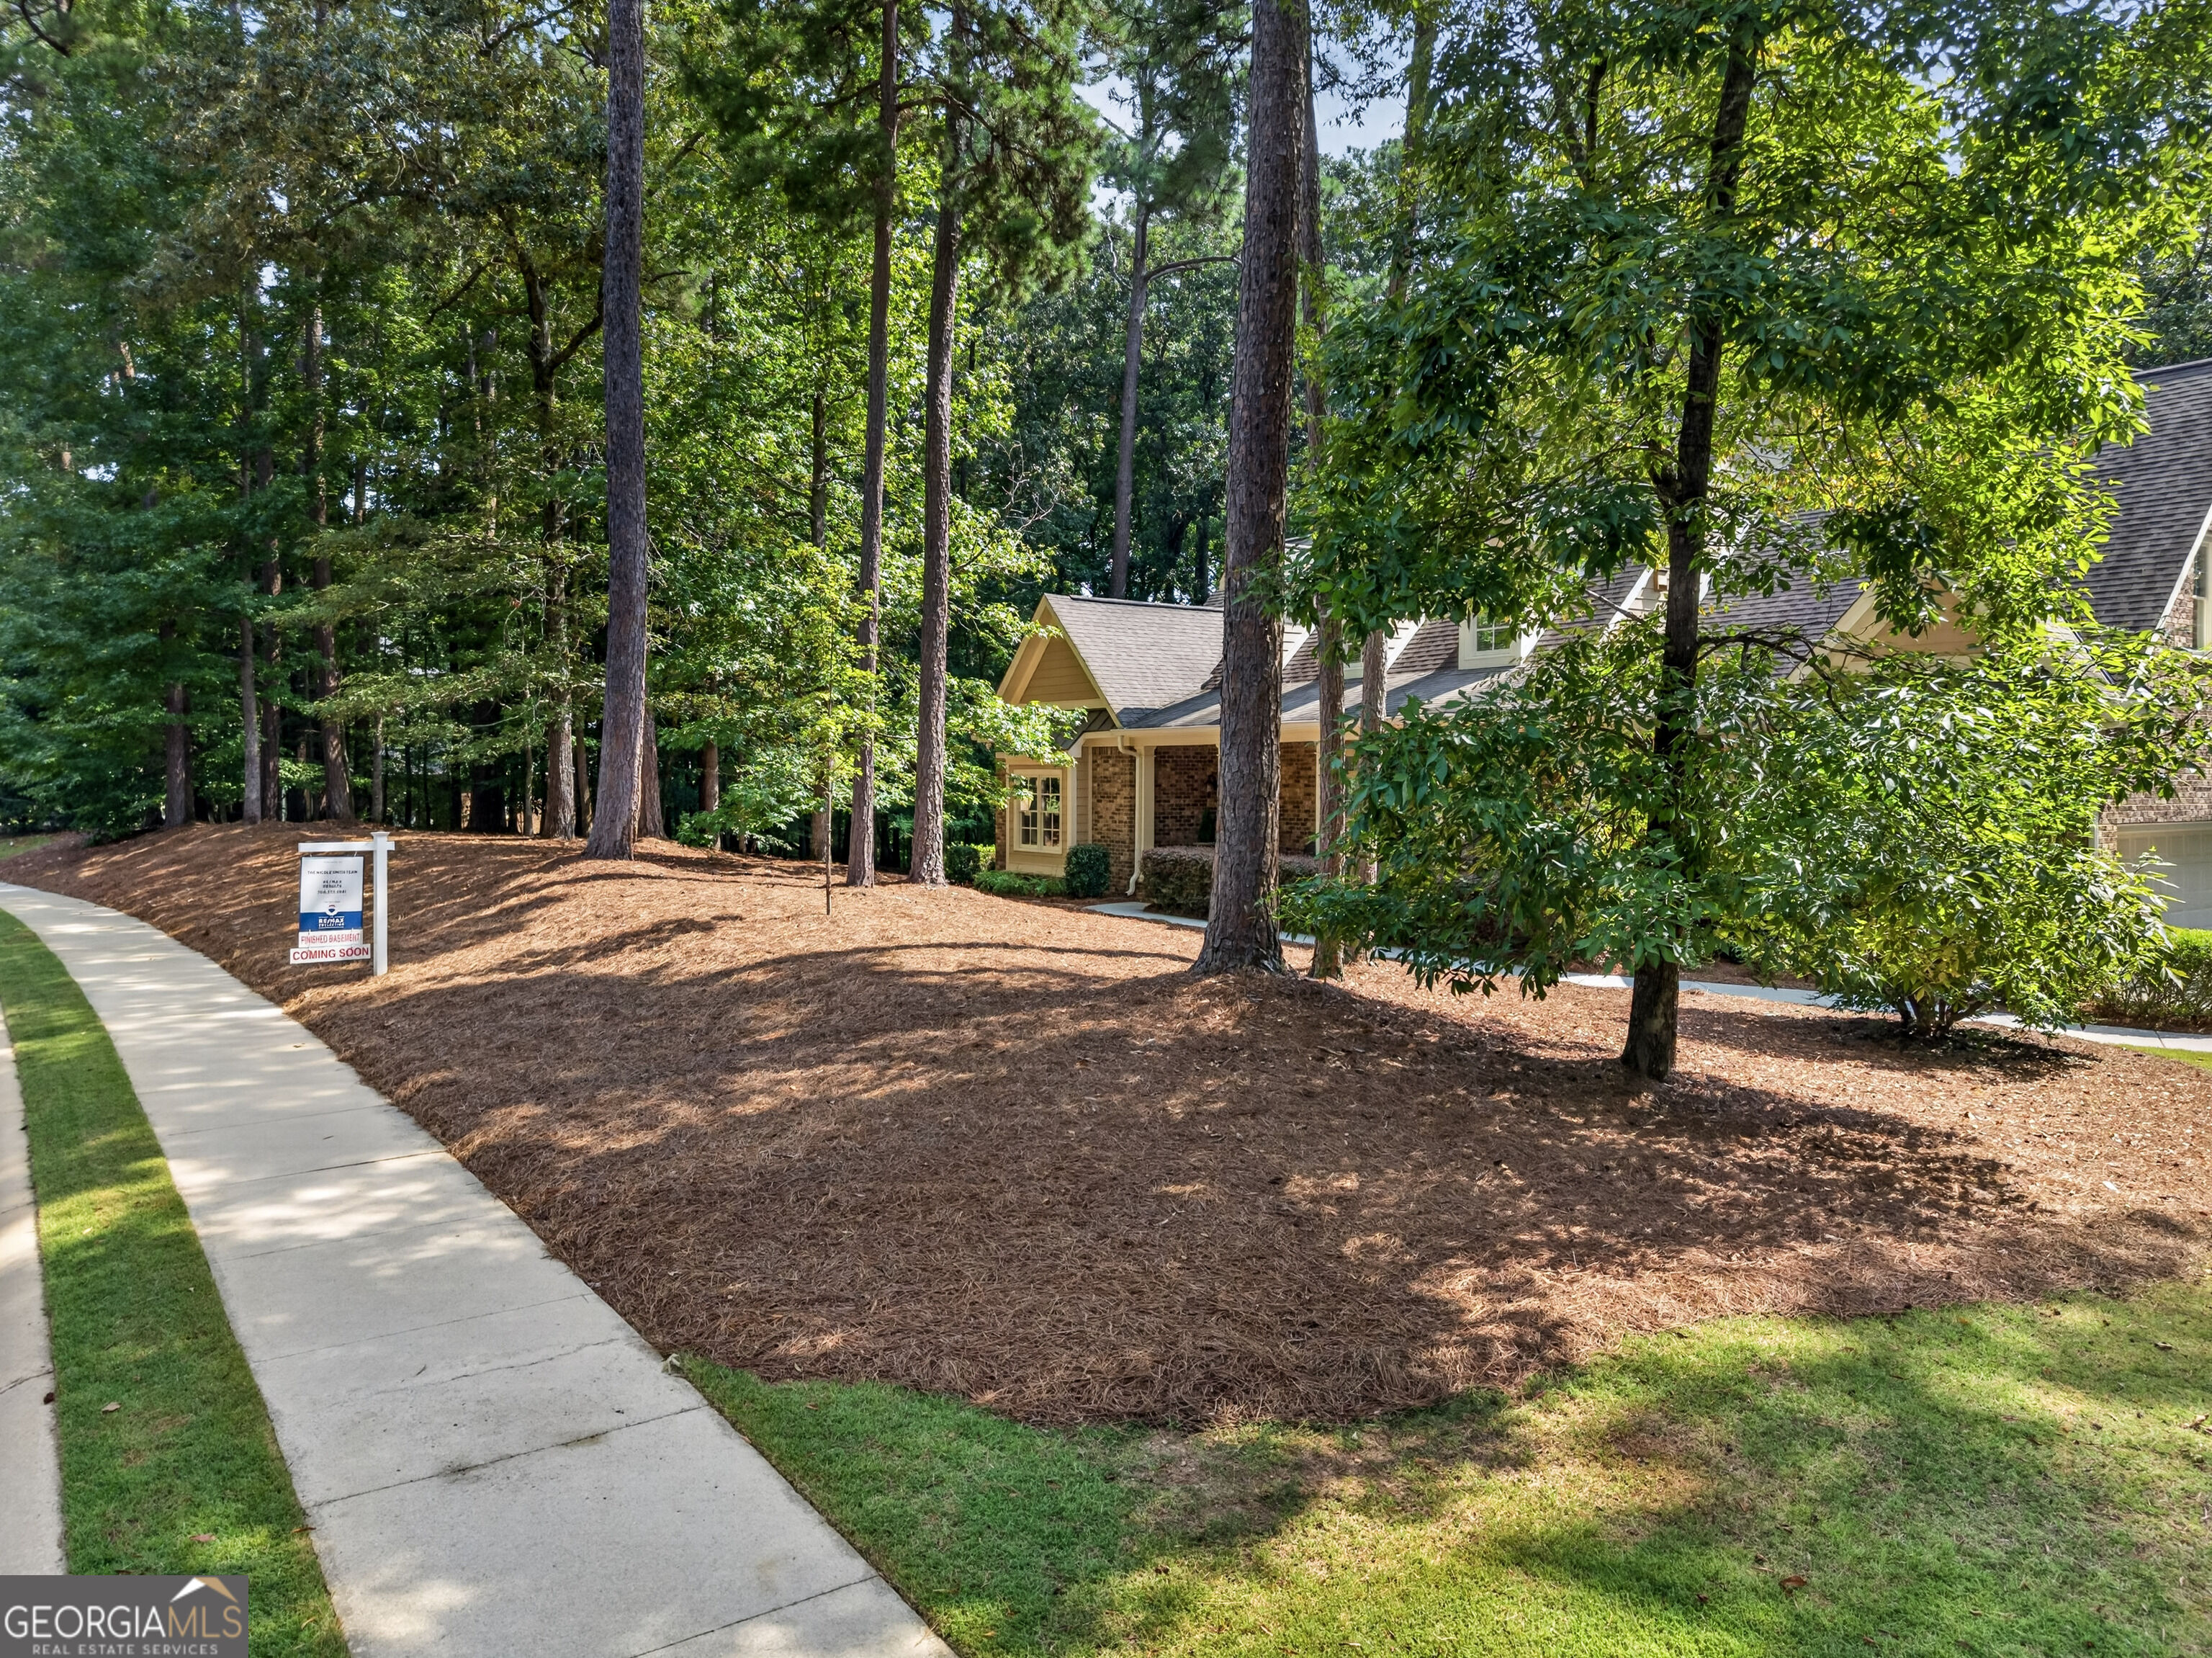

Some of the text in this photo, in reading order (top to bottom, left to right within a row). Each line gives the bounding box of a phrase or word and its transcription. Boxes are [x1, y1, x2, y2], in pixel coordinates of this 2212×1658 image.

[301, 933, 360, 944] FINISHED BASEMENT
[293, 947, 369, 960] COMING SOON
